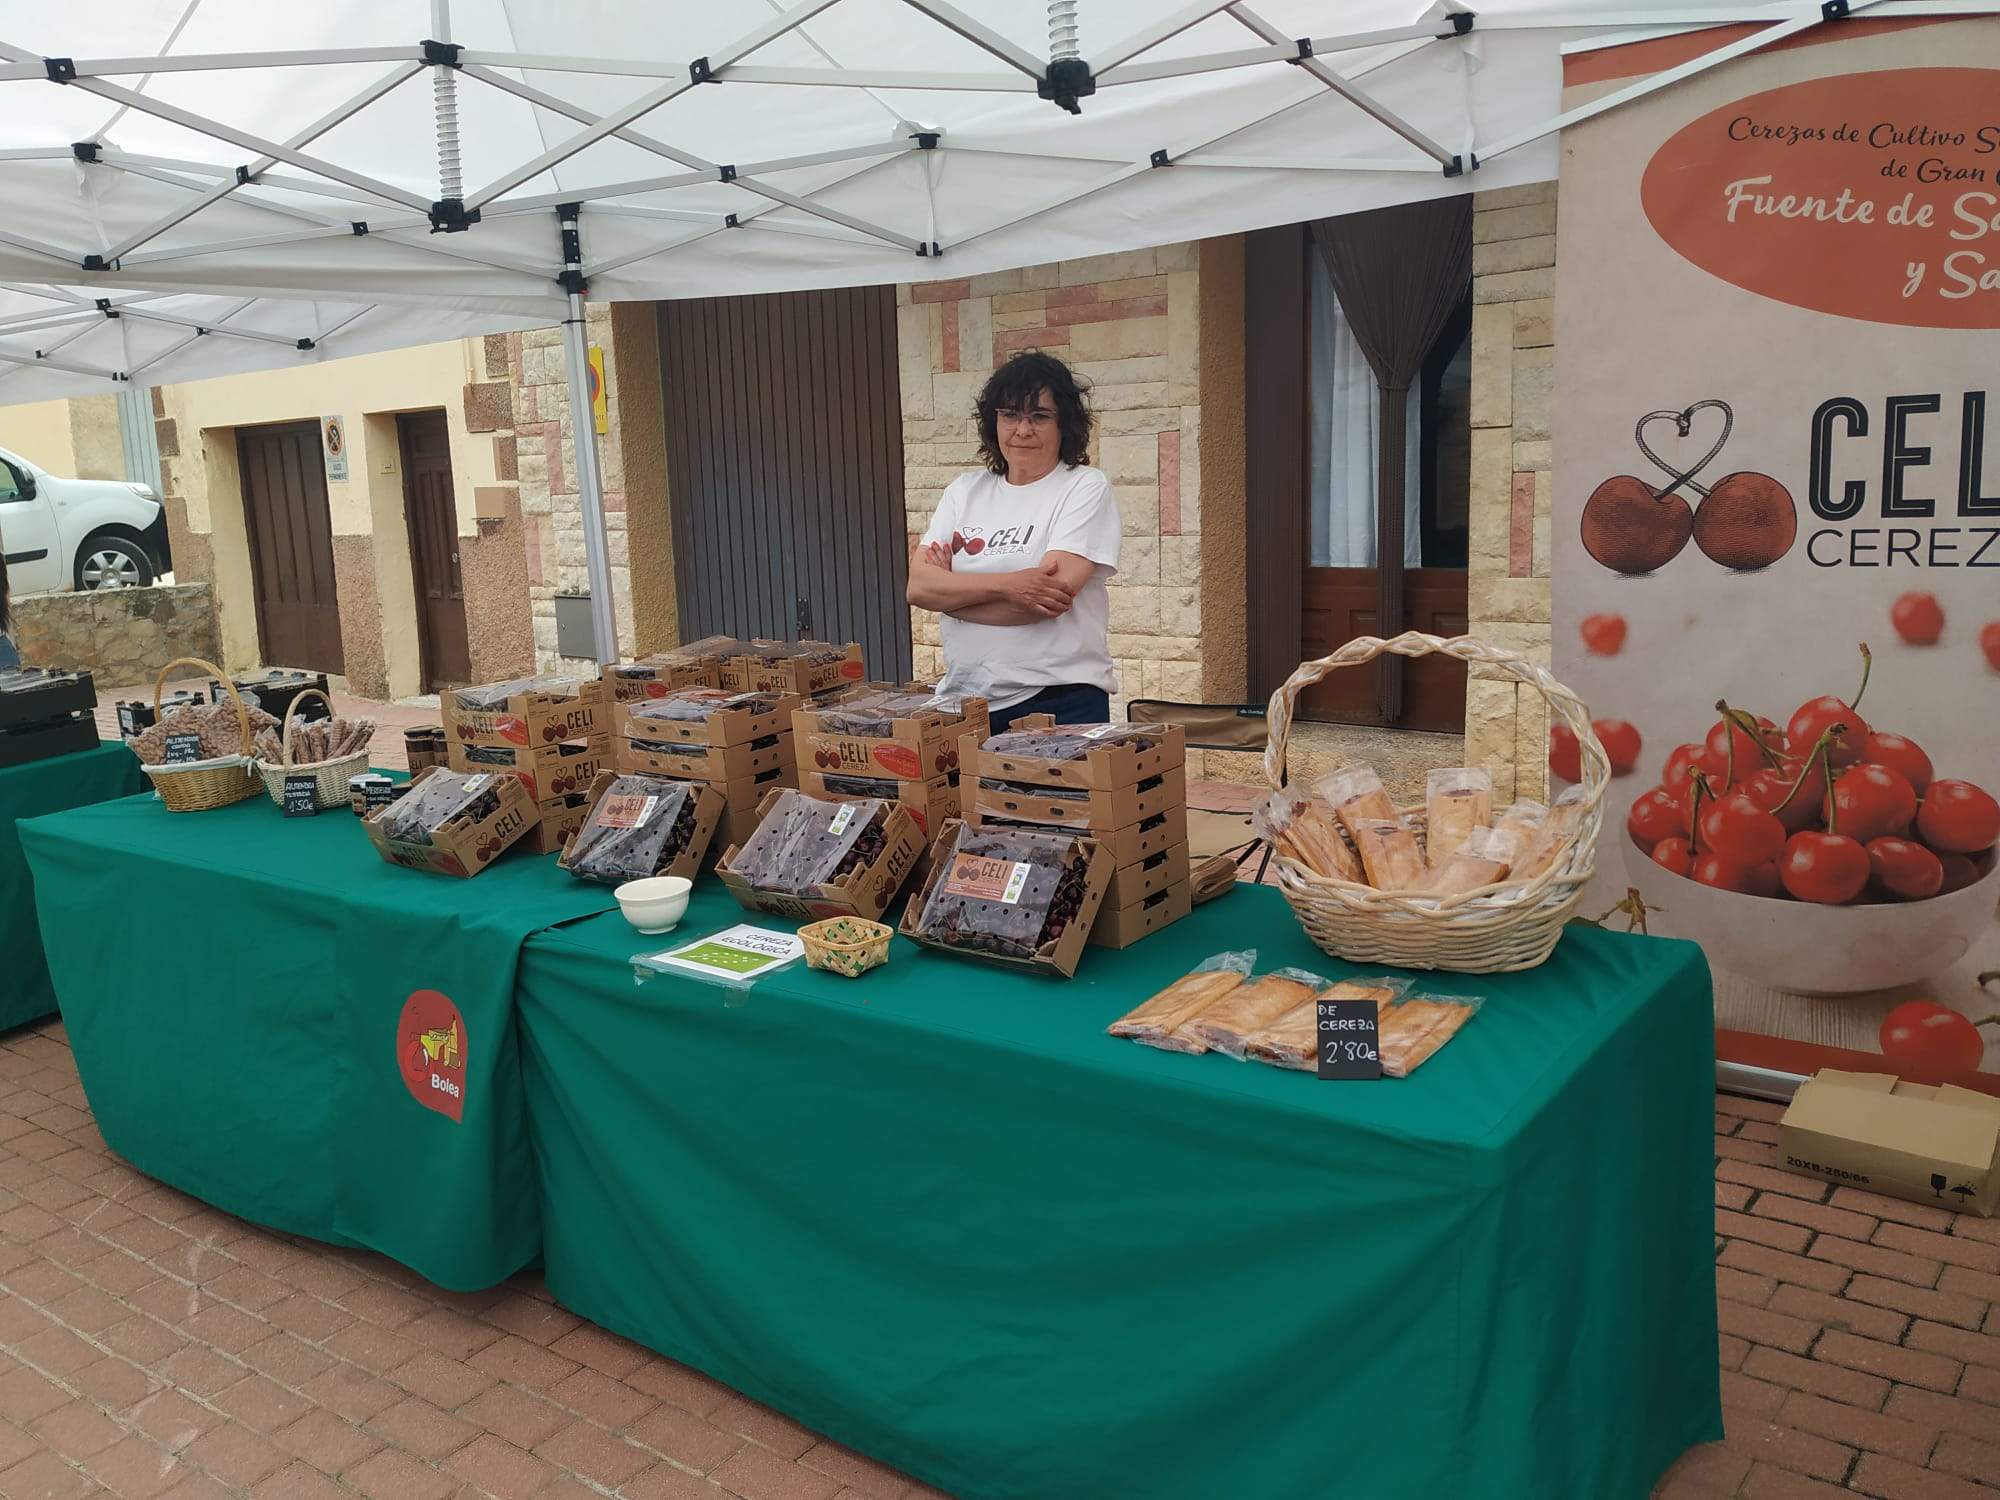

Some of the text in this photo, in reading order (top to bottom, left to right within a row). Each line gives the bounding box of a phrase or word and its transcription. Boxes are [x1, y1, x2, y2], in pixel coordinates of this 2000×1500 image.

[1728, 117, 2000, 153] Cerezas de Cultivo S
[1881, 158, 1907, 178] de
[1916, 158, 1985, 183] Gran
[1724, 175, 1875, 223] Fuente
[1887, 192, 1935, 228] de
[1902, 262, 1926, 298] y
[1809, 391, 2000, 521] CEL
[988, 525, 1034, 548] CELI
[1807, 528, 2000, 567] CEREZ
[984, 546, 1024, 555] CEREZA
[771, 676, 787, 688] CELI
[473, 716, 493, 734] CELI
[567, 709, 593, 729] CELI
[840, 741, 869, 763] CELI
[494, 808, 523, 838] CELI
[887, 838, 912, 876] CELI
[981, 862, 1008, 880] CELI
[746, 934, 793, 946] CEREZA
[1318, 1005, 1337, 1016] DE
[1319, 1019, 1375, 1031] CEREZA
[431, 1073, 460, 1098] Bolea
